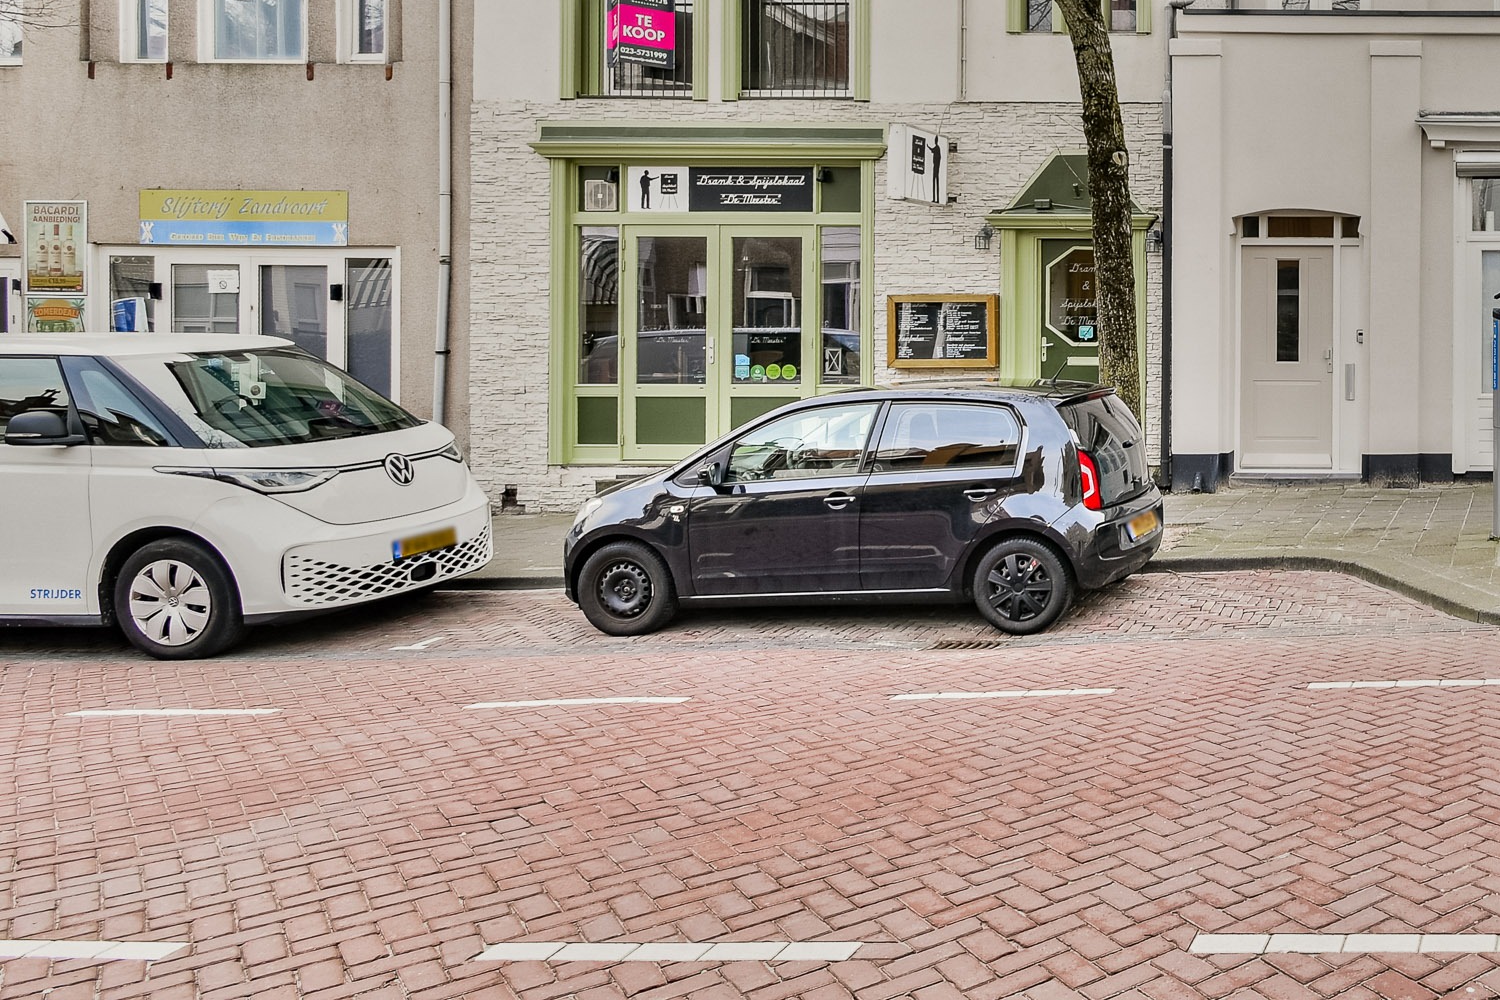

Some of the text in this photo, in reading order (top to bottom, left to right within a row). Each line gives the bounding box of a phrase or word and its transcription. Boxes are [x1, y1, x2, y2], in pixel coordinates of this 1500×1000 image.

[635, 13, 653, 27] TE
[622, 25, 666, 42] KOOP
[620, 46, 668, 60] 023-5731999
[697, 174, 806, 190] Drank & Spijslokaal
[33, 205, 79, 215] BACARDI
[161, 195, 329, 219] Slijterij Zandvoort
[1082, 281, 1090, 290] &
[30, 588, 82, 599] STRIJDER
